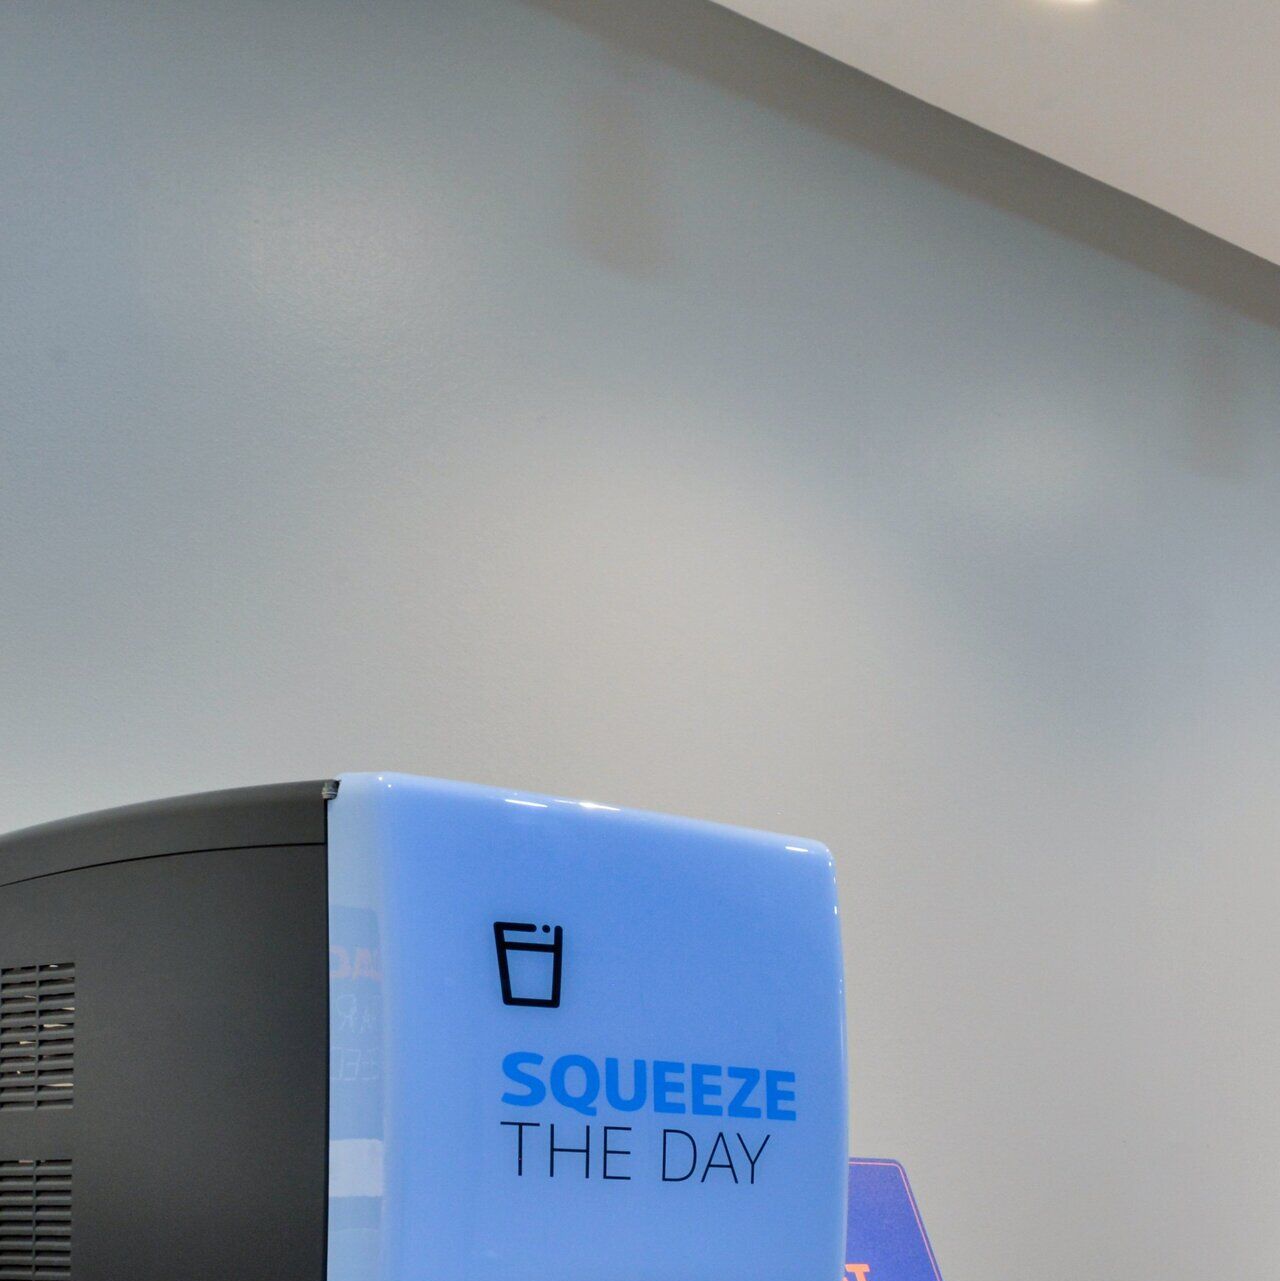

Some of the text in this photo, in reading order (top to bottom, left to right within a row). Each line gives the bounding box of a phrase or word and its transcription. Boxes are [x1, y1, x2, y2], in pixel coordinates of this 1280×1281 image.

[501, 1051, 797, 1121] SQUEEZE
[500, 1121, 770, 1184] THE DAY
